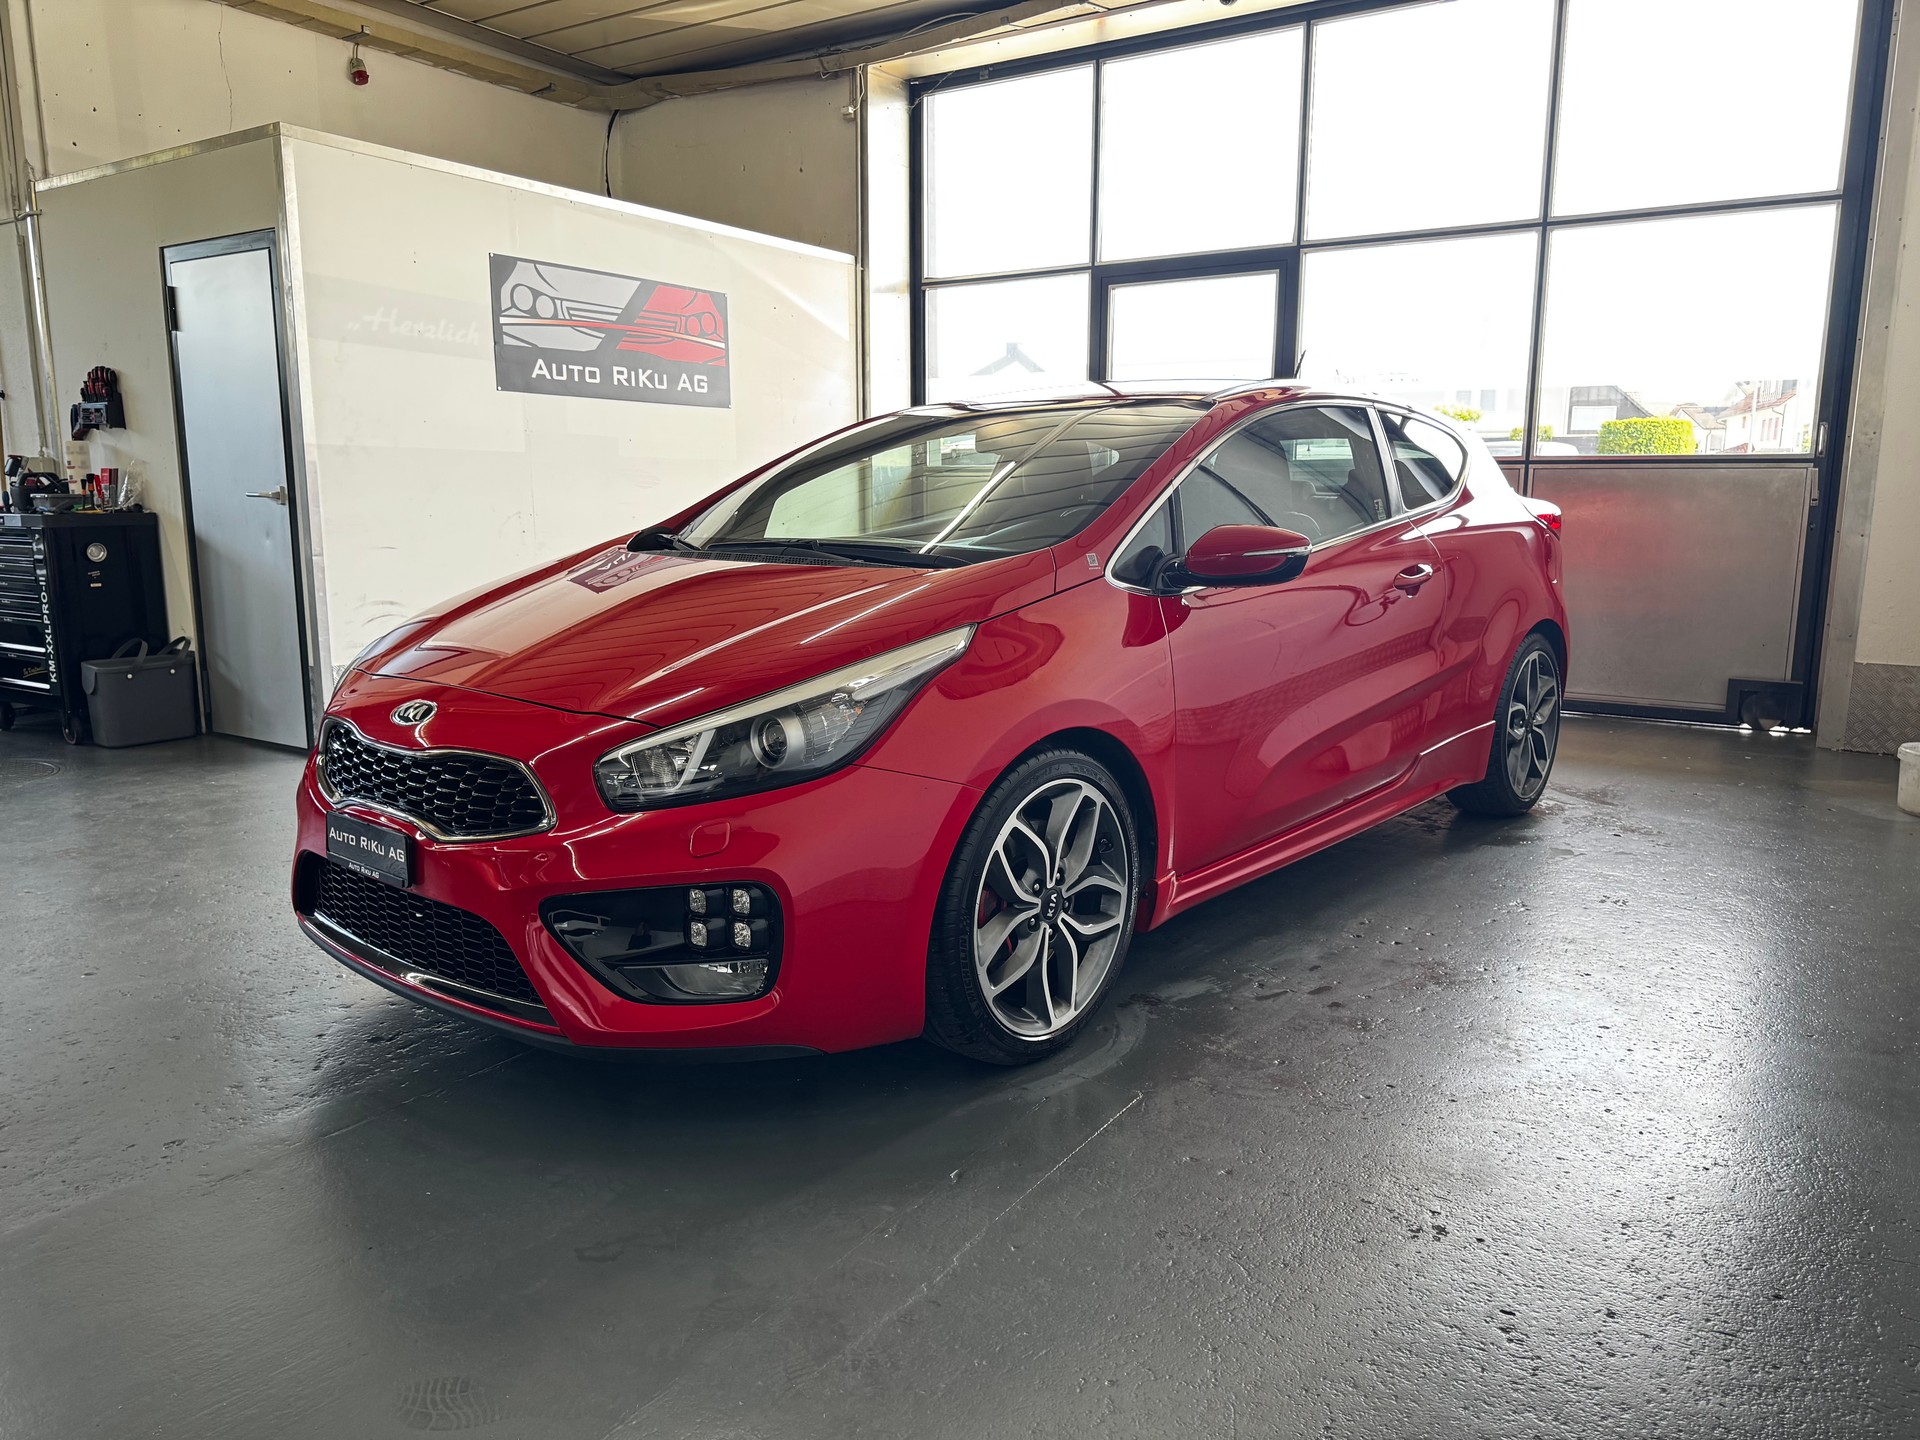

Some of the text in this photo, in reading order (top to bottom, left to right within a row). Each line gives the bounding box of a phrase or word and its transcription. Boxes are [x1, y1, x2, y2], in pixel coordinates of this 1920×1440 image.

[677, 374, 709, 394] AG
[388, 846, 405, 863] AG
[371, 870, 380, 879] AG
[1046, 893, 1058, 917] KIA
